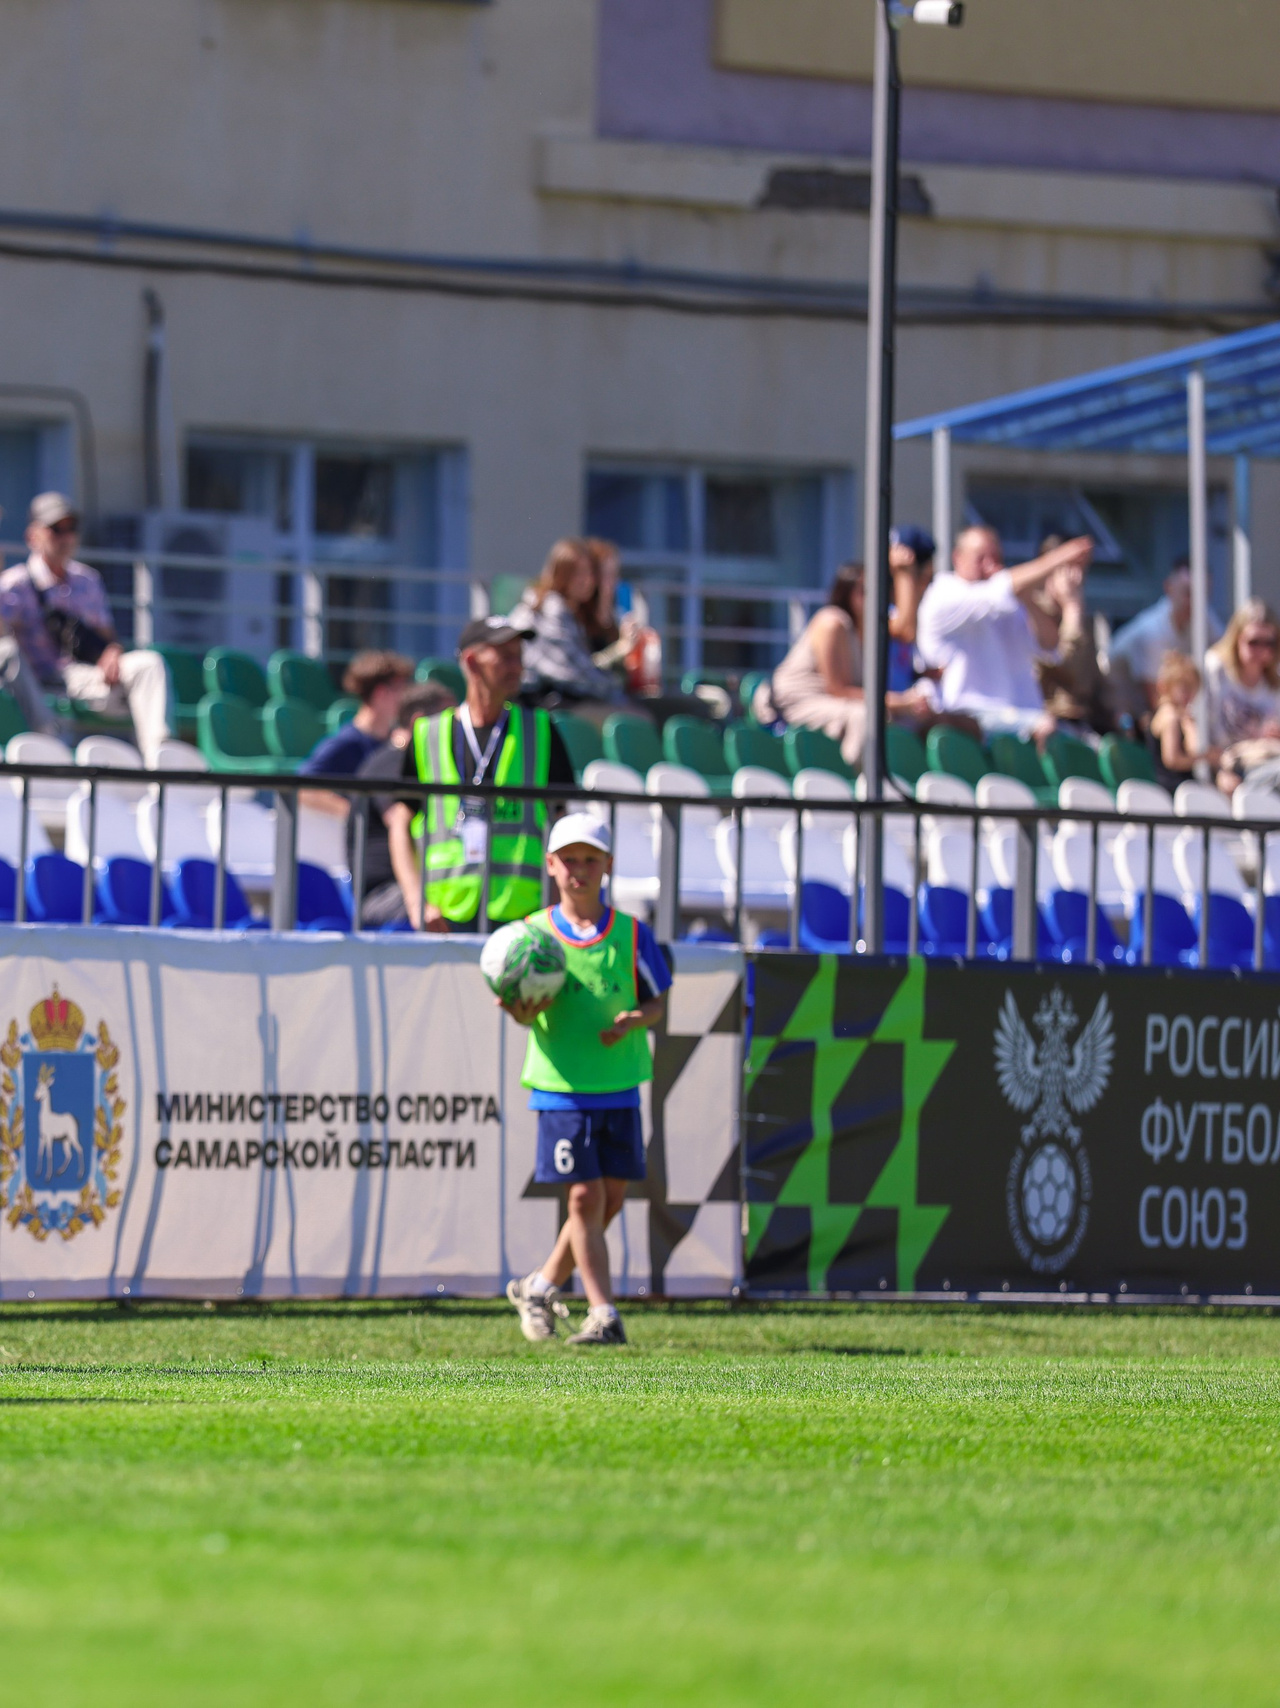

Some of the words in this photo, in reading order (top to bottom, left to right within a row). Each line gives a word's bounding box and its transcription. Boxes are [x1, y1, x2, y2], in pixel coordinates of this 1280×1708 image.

[155, 1093, 389, 1124] МИНИСТЕРСТВО
[396, 1095, 502, 1125] СПОРТА
[154, 1132, 341, 1169] САМАРСКОЙ
[348, 1139, 476, 1169] ОБЛАСТИ
[554, 1138, 575, 1175] 6
[1138, 1185, 1248, 1250] СОЮЗ
